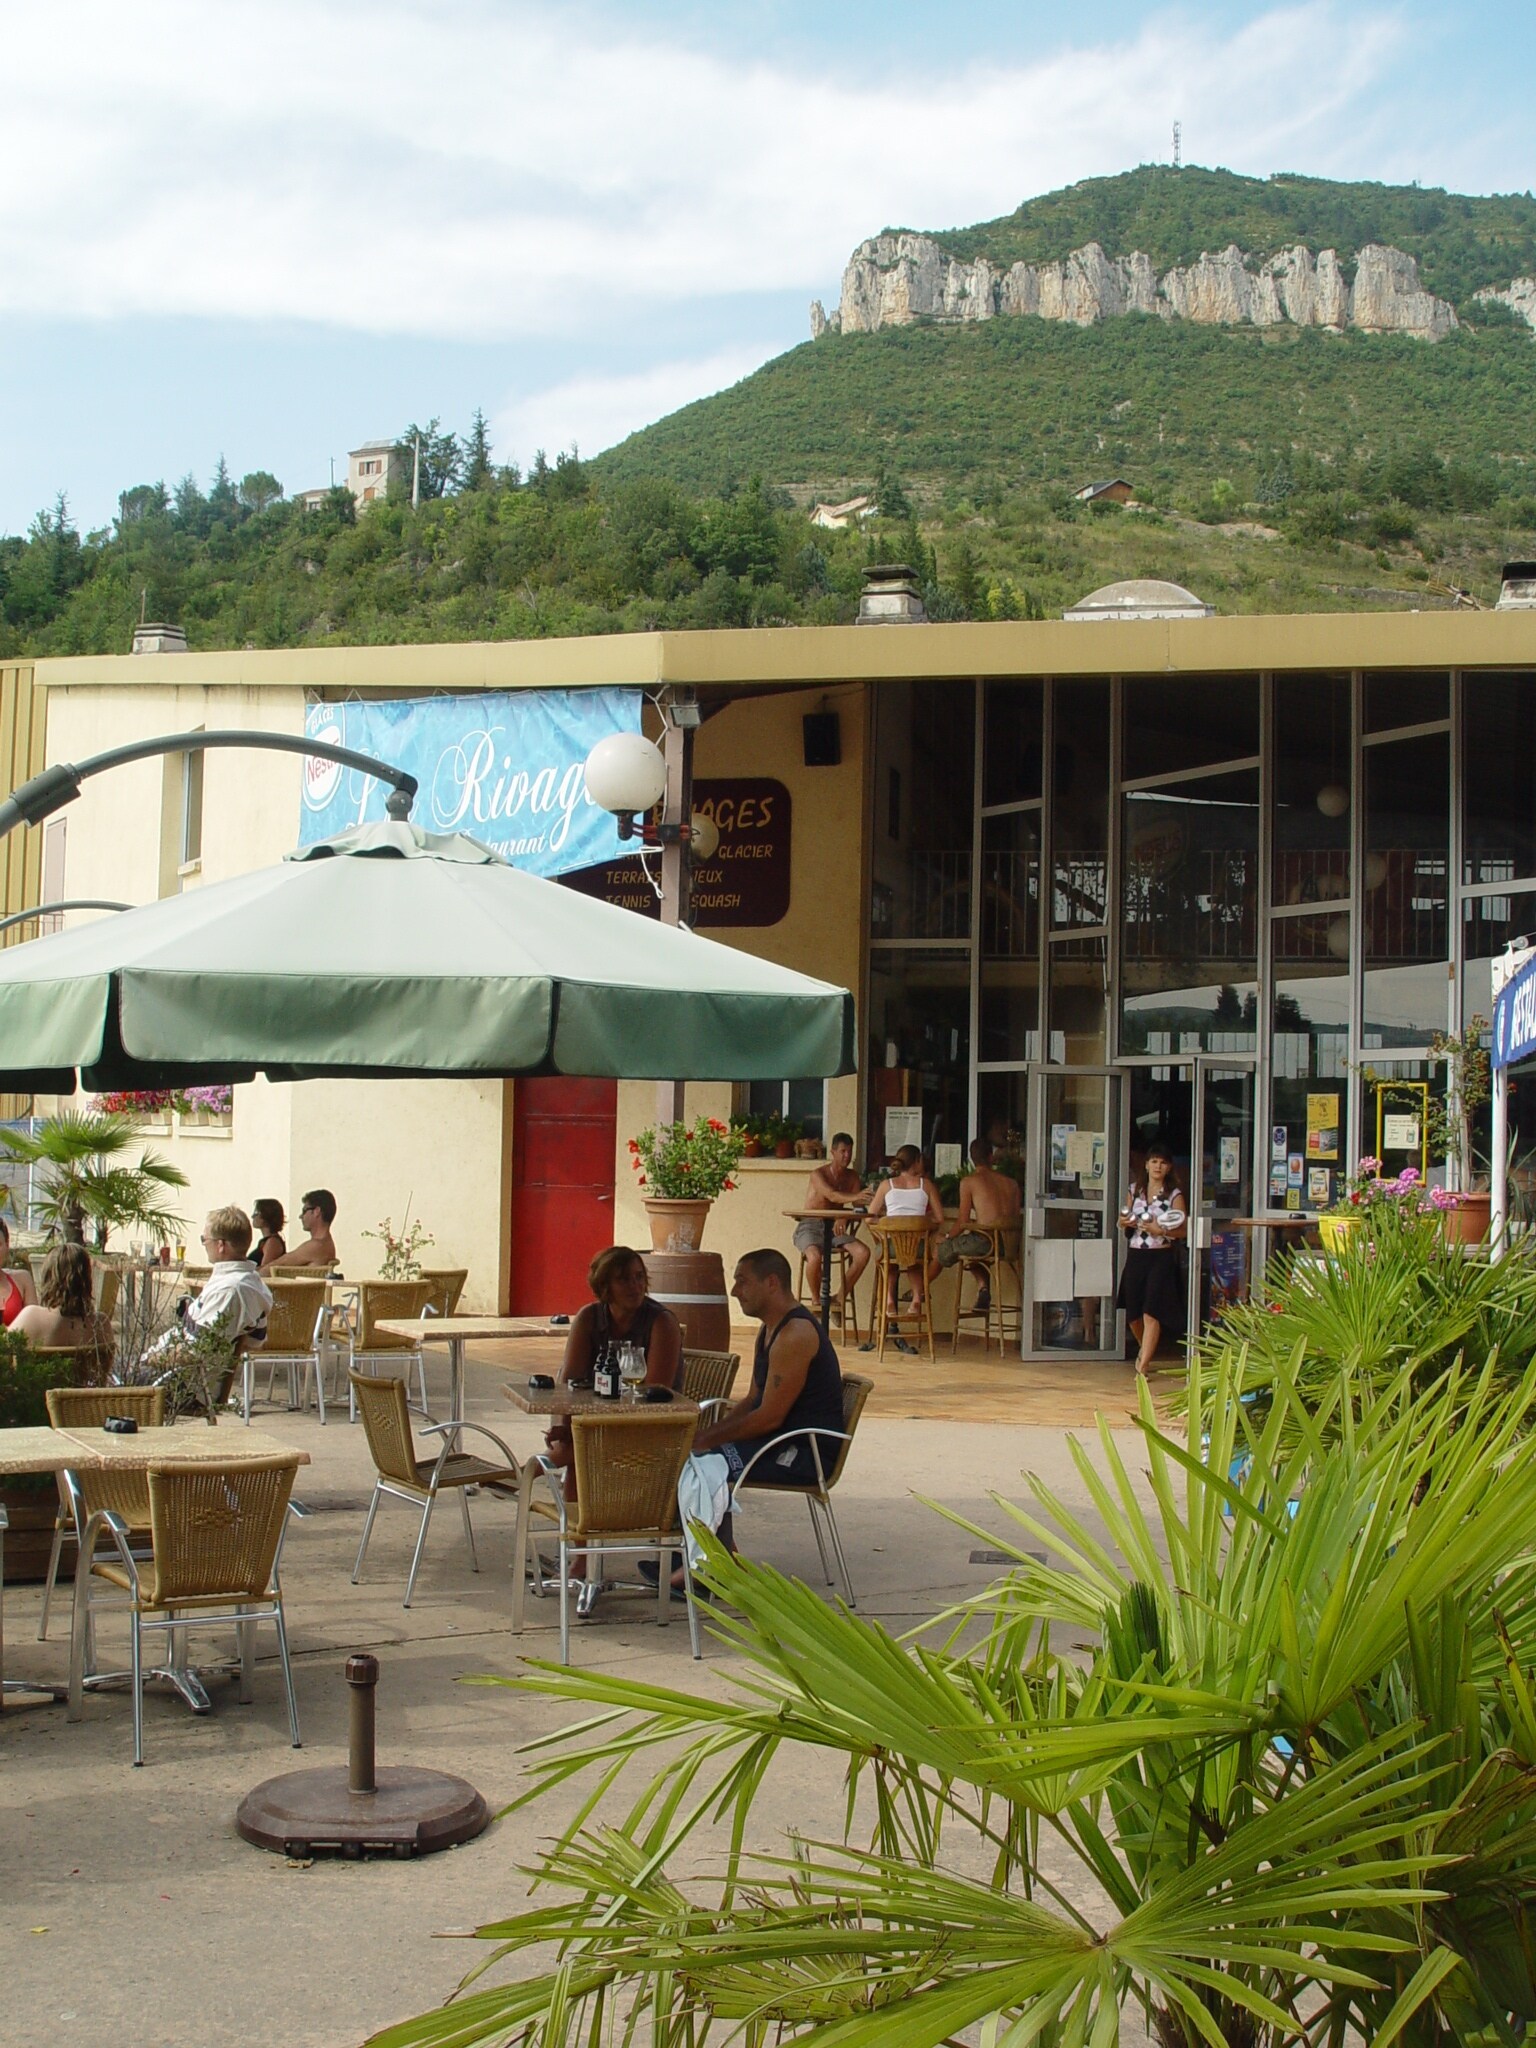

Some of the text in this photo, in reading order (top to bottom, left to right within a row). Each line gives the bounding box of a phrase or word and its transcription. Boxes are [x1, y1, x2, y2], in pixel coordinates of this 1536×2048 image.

[431, 726, 596, 852] Rivag
[718, 845, 773, 860] GLACIER
[605, 894, 741, 908] TENNIS SQUASH
